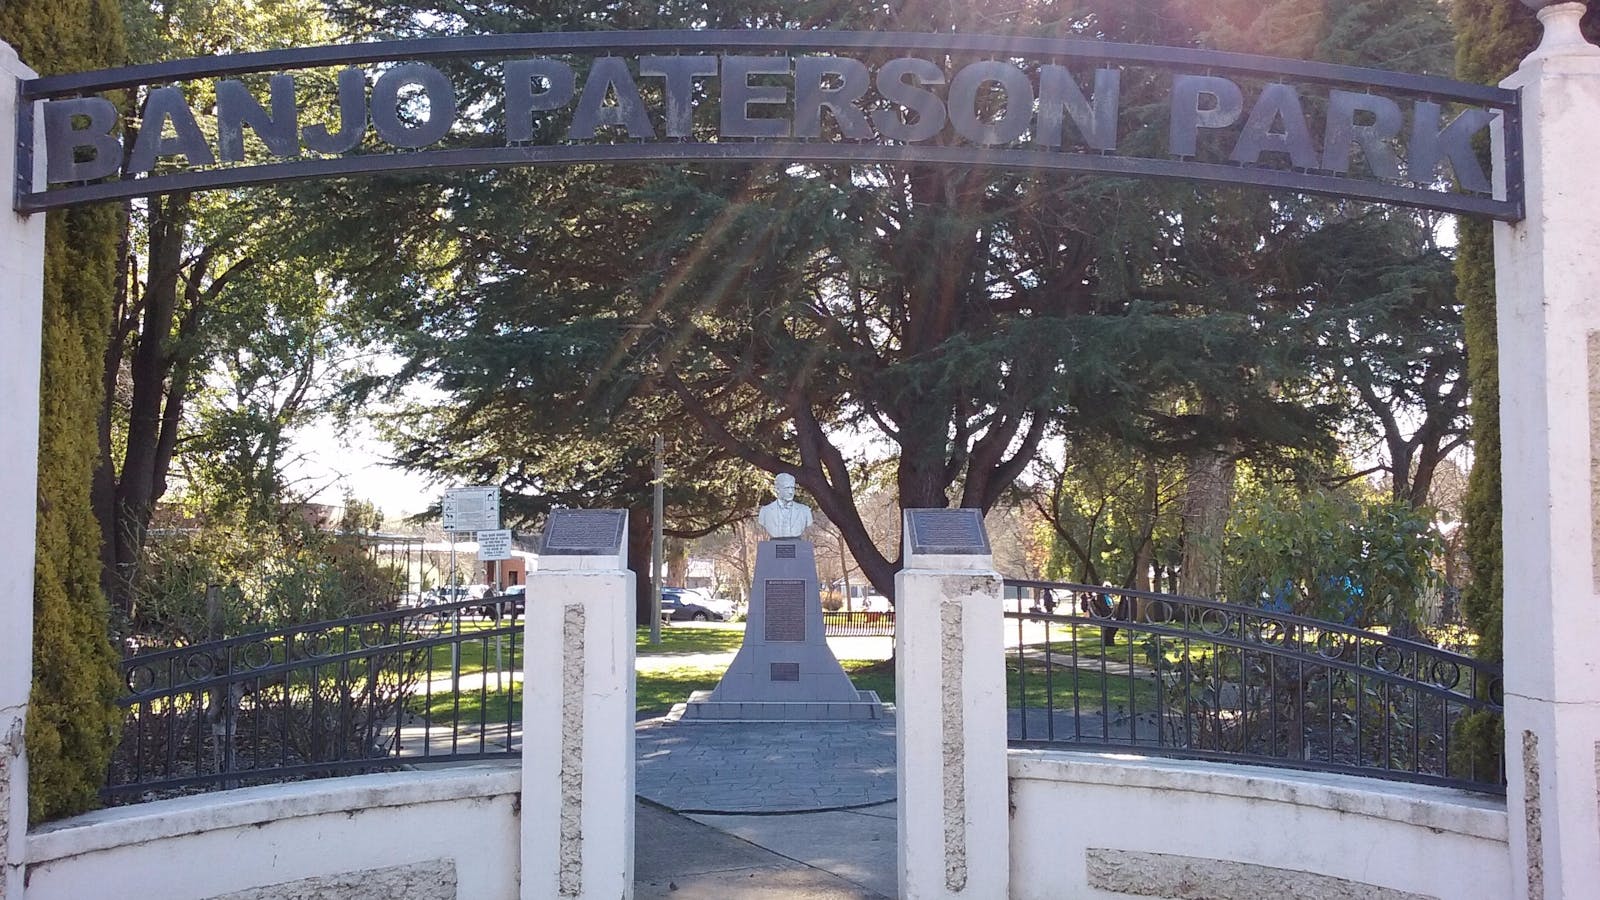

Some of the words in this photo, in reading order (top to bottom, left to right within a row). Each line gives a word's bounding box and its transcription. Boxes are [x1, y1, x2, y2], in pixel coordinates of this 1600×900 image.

[45, 61, 455, 184] BANJO
[504, 54, 1120, 152] PATERSON
[1169, 74, 1497, 193] PARK
